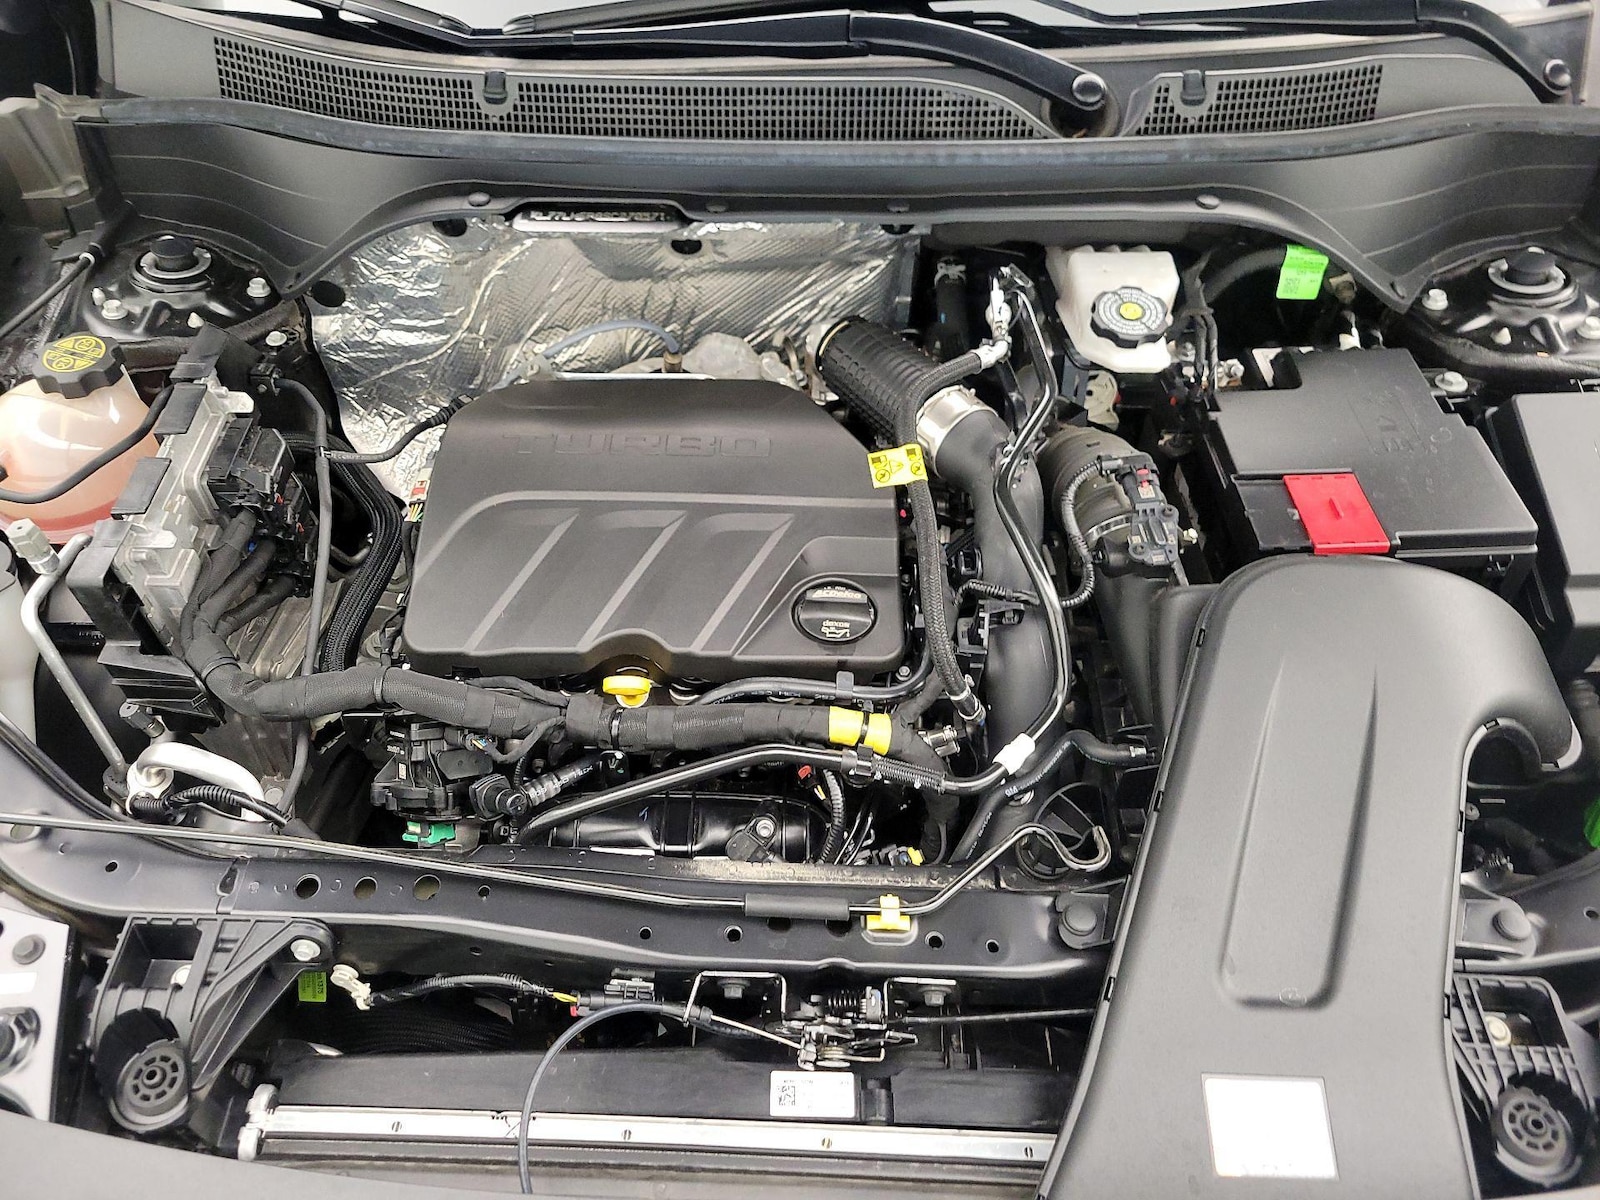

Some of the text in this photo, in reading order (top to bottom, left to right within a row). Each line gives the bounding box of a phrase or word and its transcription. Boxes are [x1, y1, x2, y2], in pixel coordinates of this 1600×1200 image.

[502, 433, 772, 457] TURBO
[812, 589, 862, 599] ACDelco
[822, 620, 850, 628] dexos
